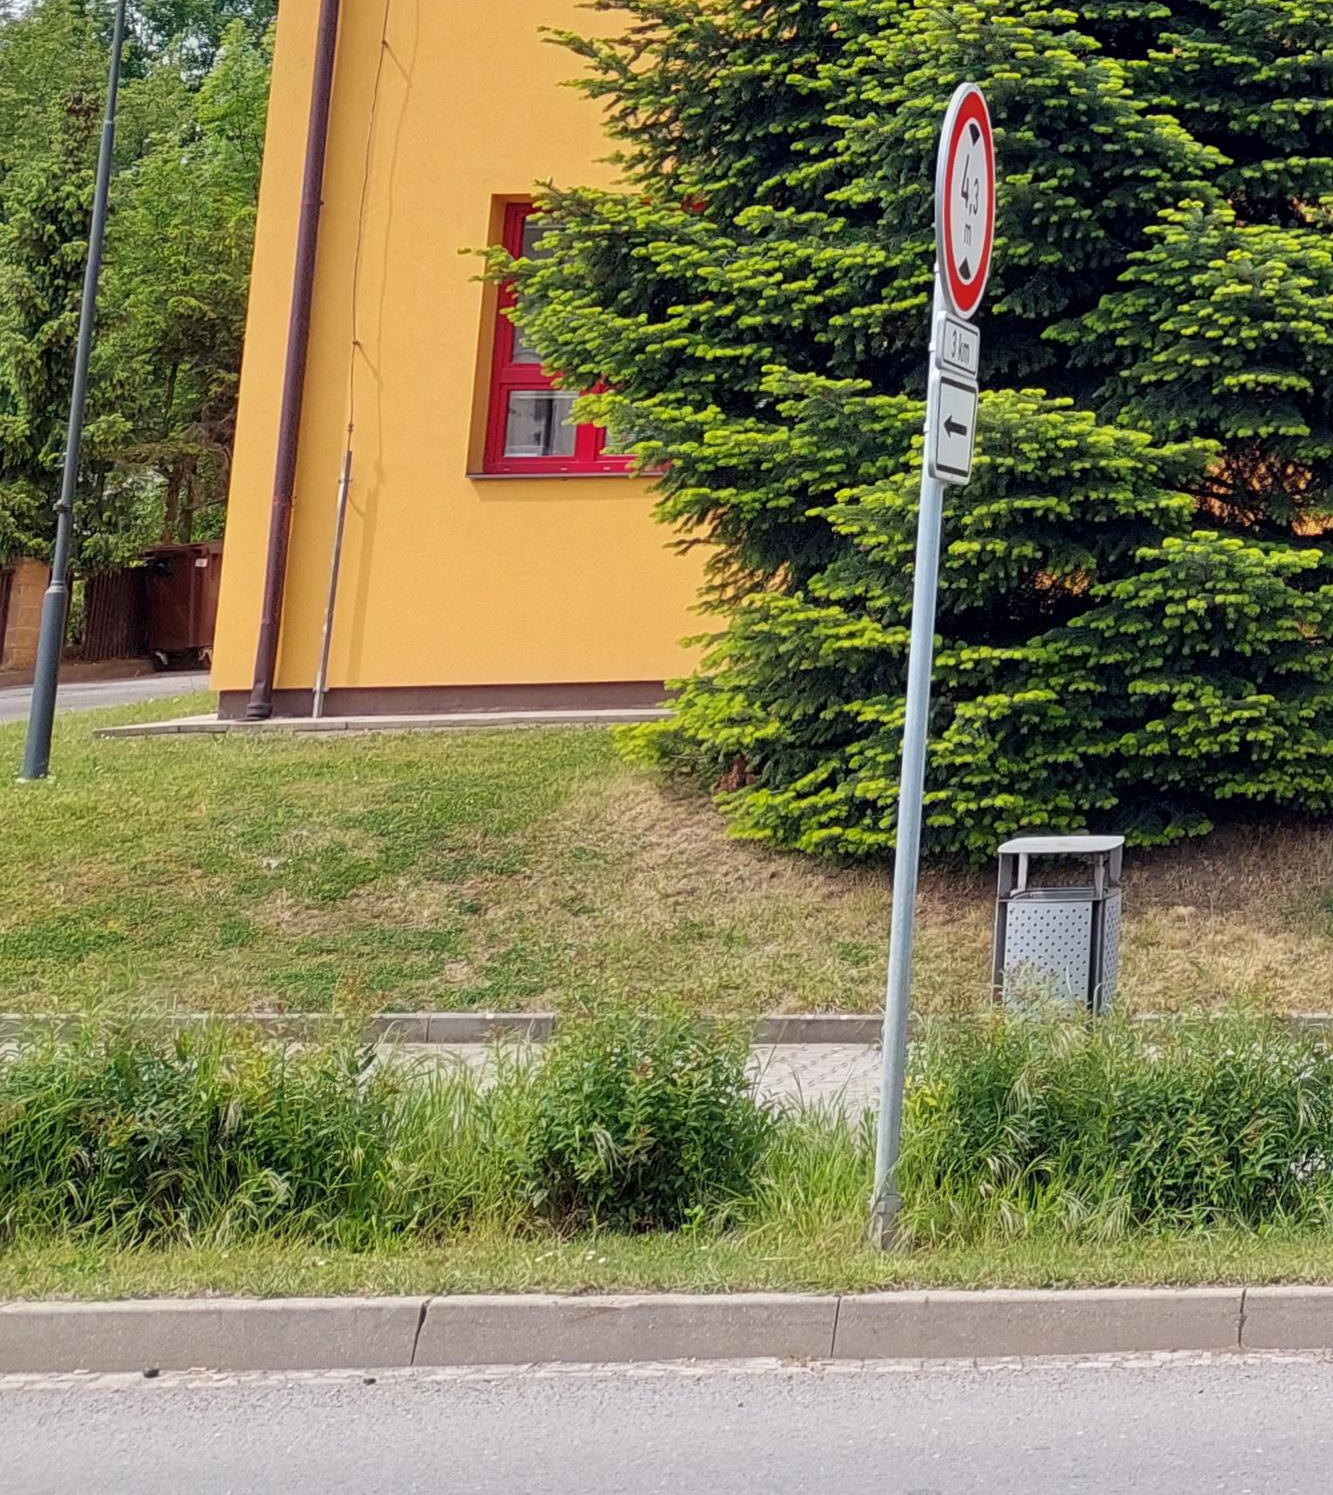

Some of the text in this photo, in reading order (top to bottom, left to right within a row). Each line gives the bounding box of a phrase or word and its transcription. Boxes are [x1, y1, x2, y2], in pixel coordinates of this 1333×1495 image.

[961, 153, 979, 215] 4,3
[963, 223, 972, 246] m
[951, 329, 969, 365] 3 km
